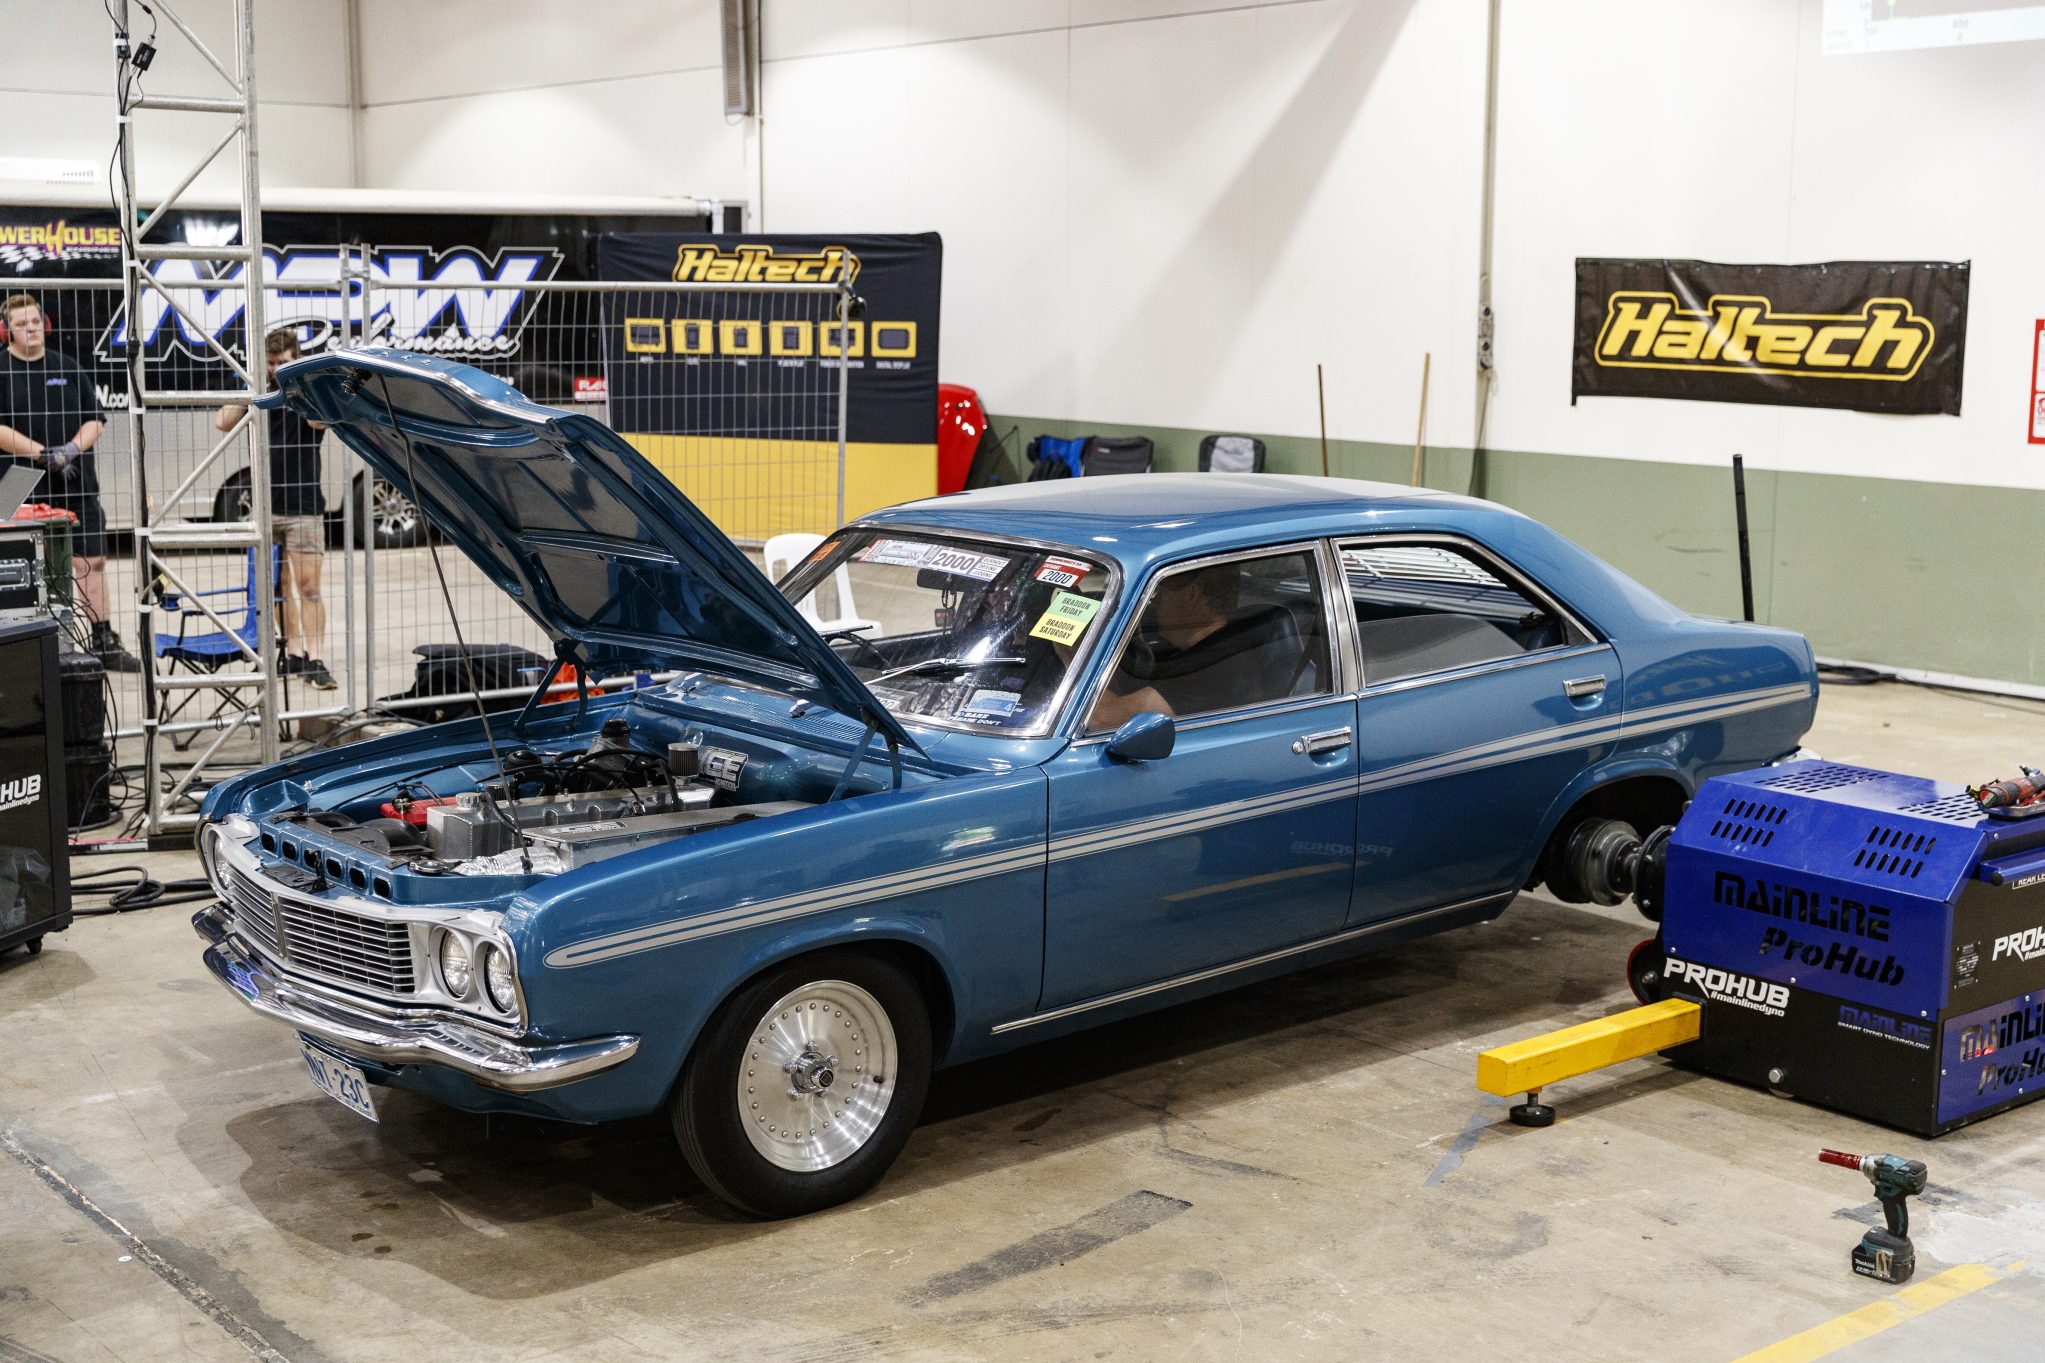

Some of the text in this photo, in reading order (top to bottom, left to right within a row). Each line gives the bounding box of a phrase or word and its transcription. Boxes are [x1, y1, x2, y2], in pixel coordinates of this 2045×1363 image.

[675, 248, 857, 283] Haltech
[1600, 302, 1924, 370] Haltech
[932, 552, 976, 571] 2000
[1042, 570, 1073, 584] 2000
[1059, 605, 1084, 617] FRIDAY
[1062, 597, 1092, 610] BRADDON
[1039, 625, 1072, 640] SATURDAY
[1045, 618, 1076, 632] BRADDON
[0, 774, 41, 803] HUB
[1759, 927, 1905, 986] ProHub
[1663, 957, 1790, 1009] PROHUB
[1710, 990, 1785, 1017] #mainlinedyno
[1837, 1021, 1930, 1050] SMART DYNO TECHNOLOGY
